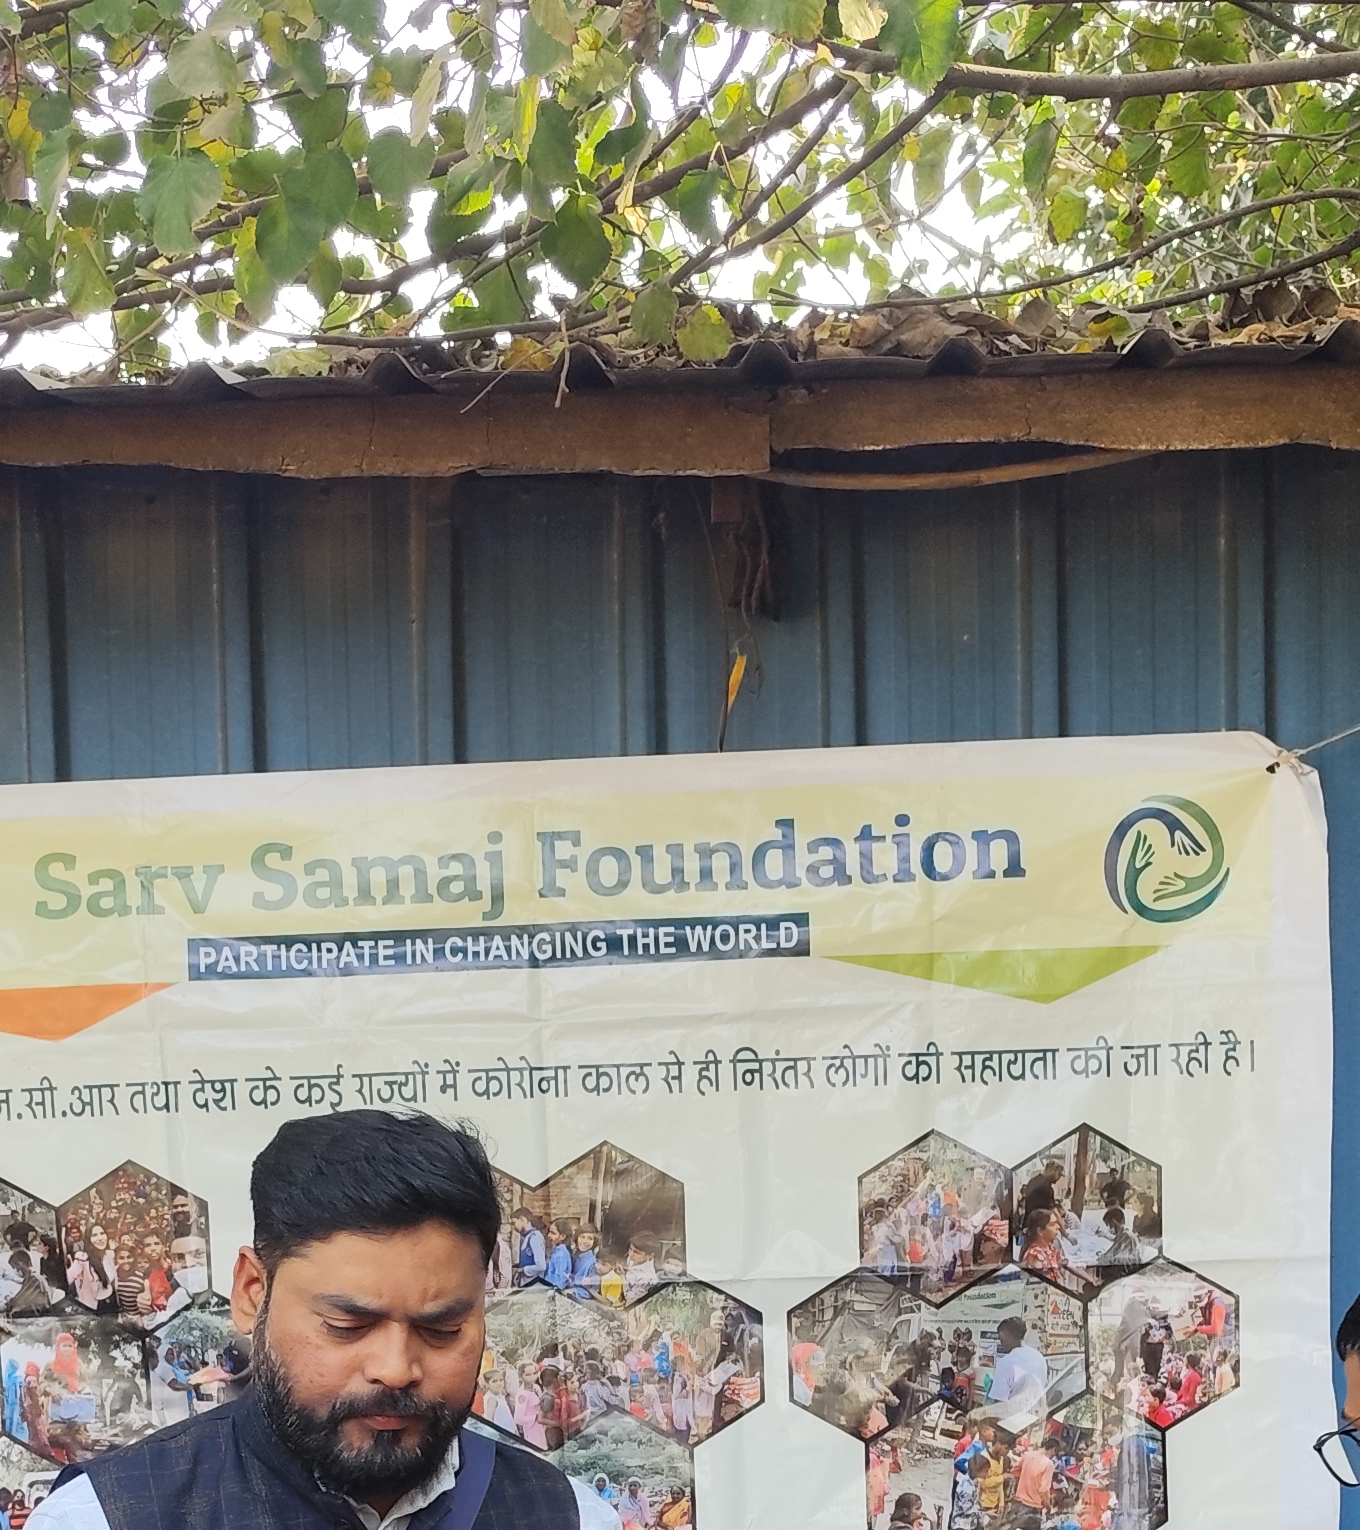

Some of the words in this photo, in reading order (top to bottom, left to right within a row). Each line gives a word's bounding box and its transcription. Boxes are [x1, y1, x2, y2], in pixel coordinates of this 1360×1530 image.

[34, 852, 225, 920] Sarv
[250, 830, 506, 922] Samaj
[536, 813, 1027, 898] Foundation
[198, 938, 396, 974] PARTICIPATE
[404, 936, 435, 966] IN
[444, 928, 607, 964] CHANGING
[616, 926, 677, 956] THE
[684, 920, 800, 953] WORLD
[126, 1081, 181, 1113] तथा
[189, 1069, 237, 1112] देश
[245, 1066, 282, 1109] के
[290, 1064, 344, 1112] कई
[351, 1060, 429, 1106] राज्यों
[436, 1059, 460, 1101] में
[468, 1056, 571, 1100] कोरोना
[578, 1063, 652, 1096] काल
[658, 1051, 685, 1093] से
[693, 1050, 722, 1096] ही
[729, 1047, 814, 1091] निरंतर
[822, 1042, 890, 1088] लोगों
[898, 1042, 943, 1084] की
[951, 1048, 1059, 1086] सहायता
[1067, 1037, 1113, 1077] की
[1121, 1044, 1161, 1076] जा
[1169, 1032, 1212, 1077] रही
